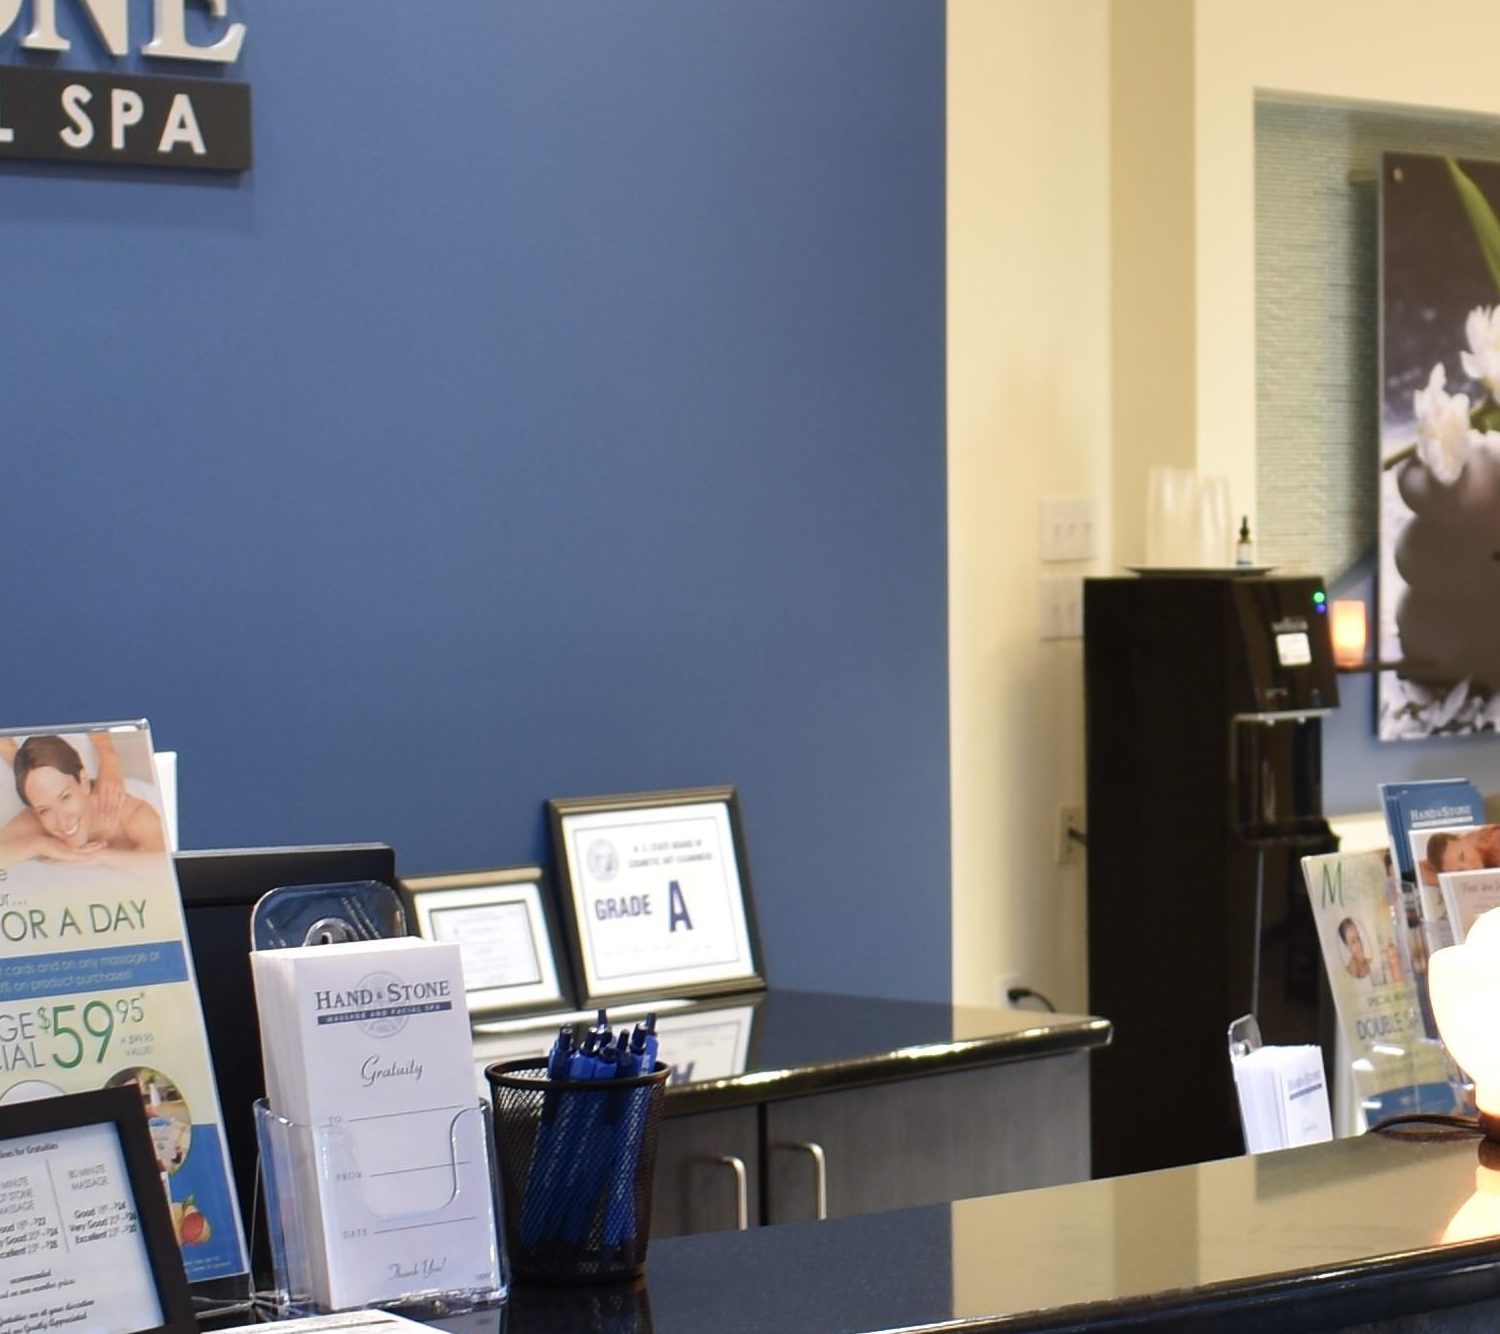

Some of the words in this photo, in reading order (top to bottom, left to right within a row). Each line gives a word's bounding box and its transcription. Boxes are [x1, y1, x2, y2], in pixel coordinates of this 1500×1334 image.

[60, 82, 206, 155] SPA
[59, 907, 83, 937] A
[88, 899, 148, 934] DAY
[594, 893, 652, 921] GRADE
[668, 880, 694, 933] A
[315, 989, 373, 1010] HAND
[387, 980, 451, 1002] STONE
[361, 1054, 423, 1087] Gratuity
